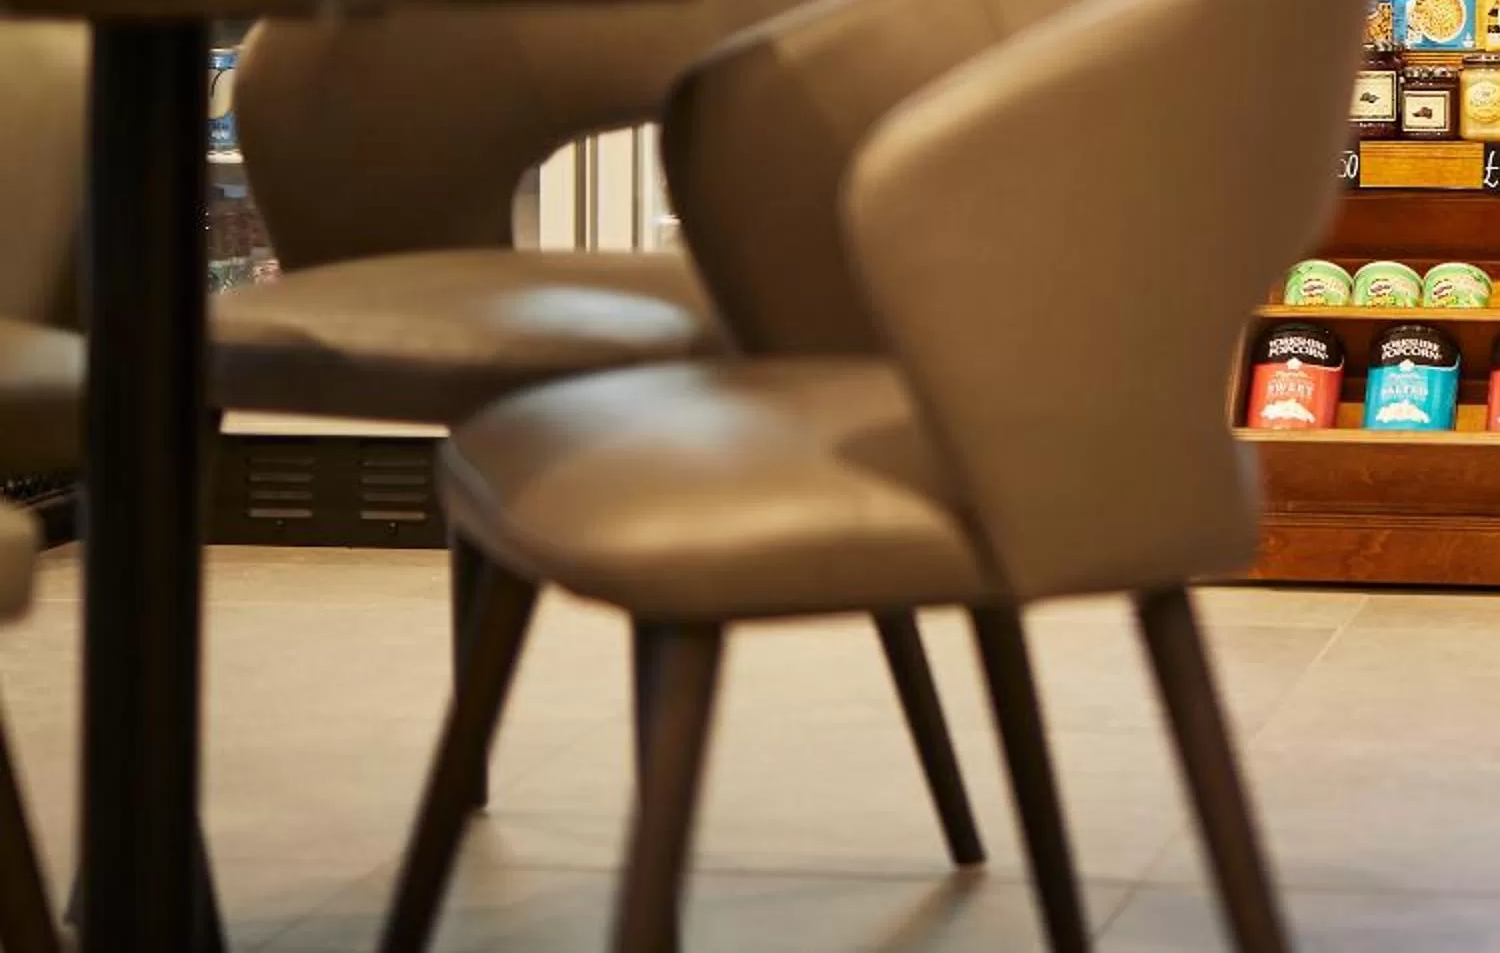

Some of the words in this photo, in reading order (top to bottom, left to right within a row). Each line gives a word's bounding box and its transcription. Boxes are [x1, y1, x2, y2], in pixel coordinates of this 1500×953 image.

[1268, 336, 1328, 351] YORKSHIRE
[1381, 338, 1440, 352] YORKSHIRE
[1268, 347, 1329, 360] POPCORN
[1381, 347, 1442, 360] POPCORN
